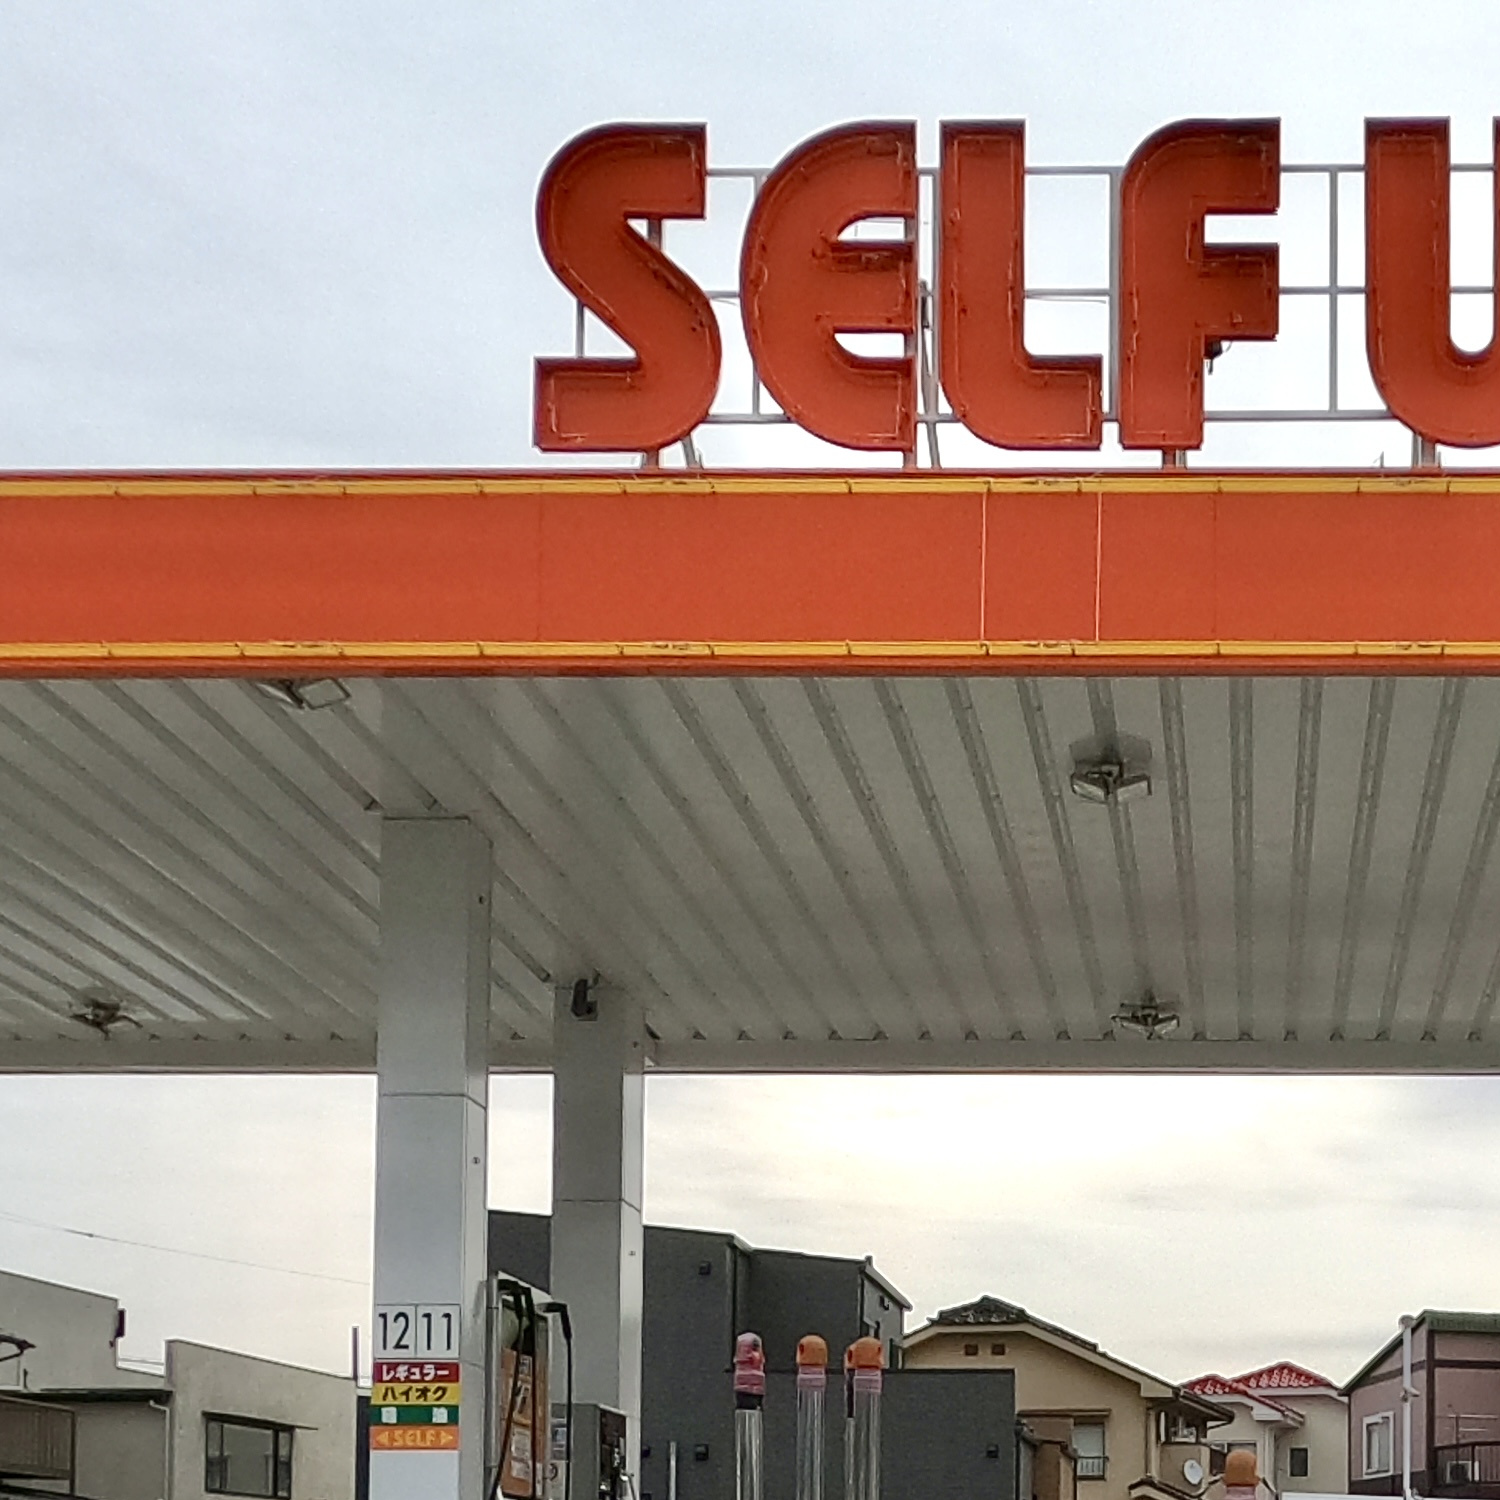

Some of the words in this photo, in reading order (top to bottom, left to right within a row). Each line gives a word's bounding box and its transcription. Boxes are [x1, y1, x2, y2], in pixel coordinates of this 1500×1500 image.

[532, 117, 1281, 451] SELF
[382, 1364, 450, 1381] レギュラー
[382, 1385, 448, 1402] ハイオク
[392, 1429, 436, 1447] SELF
